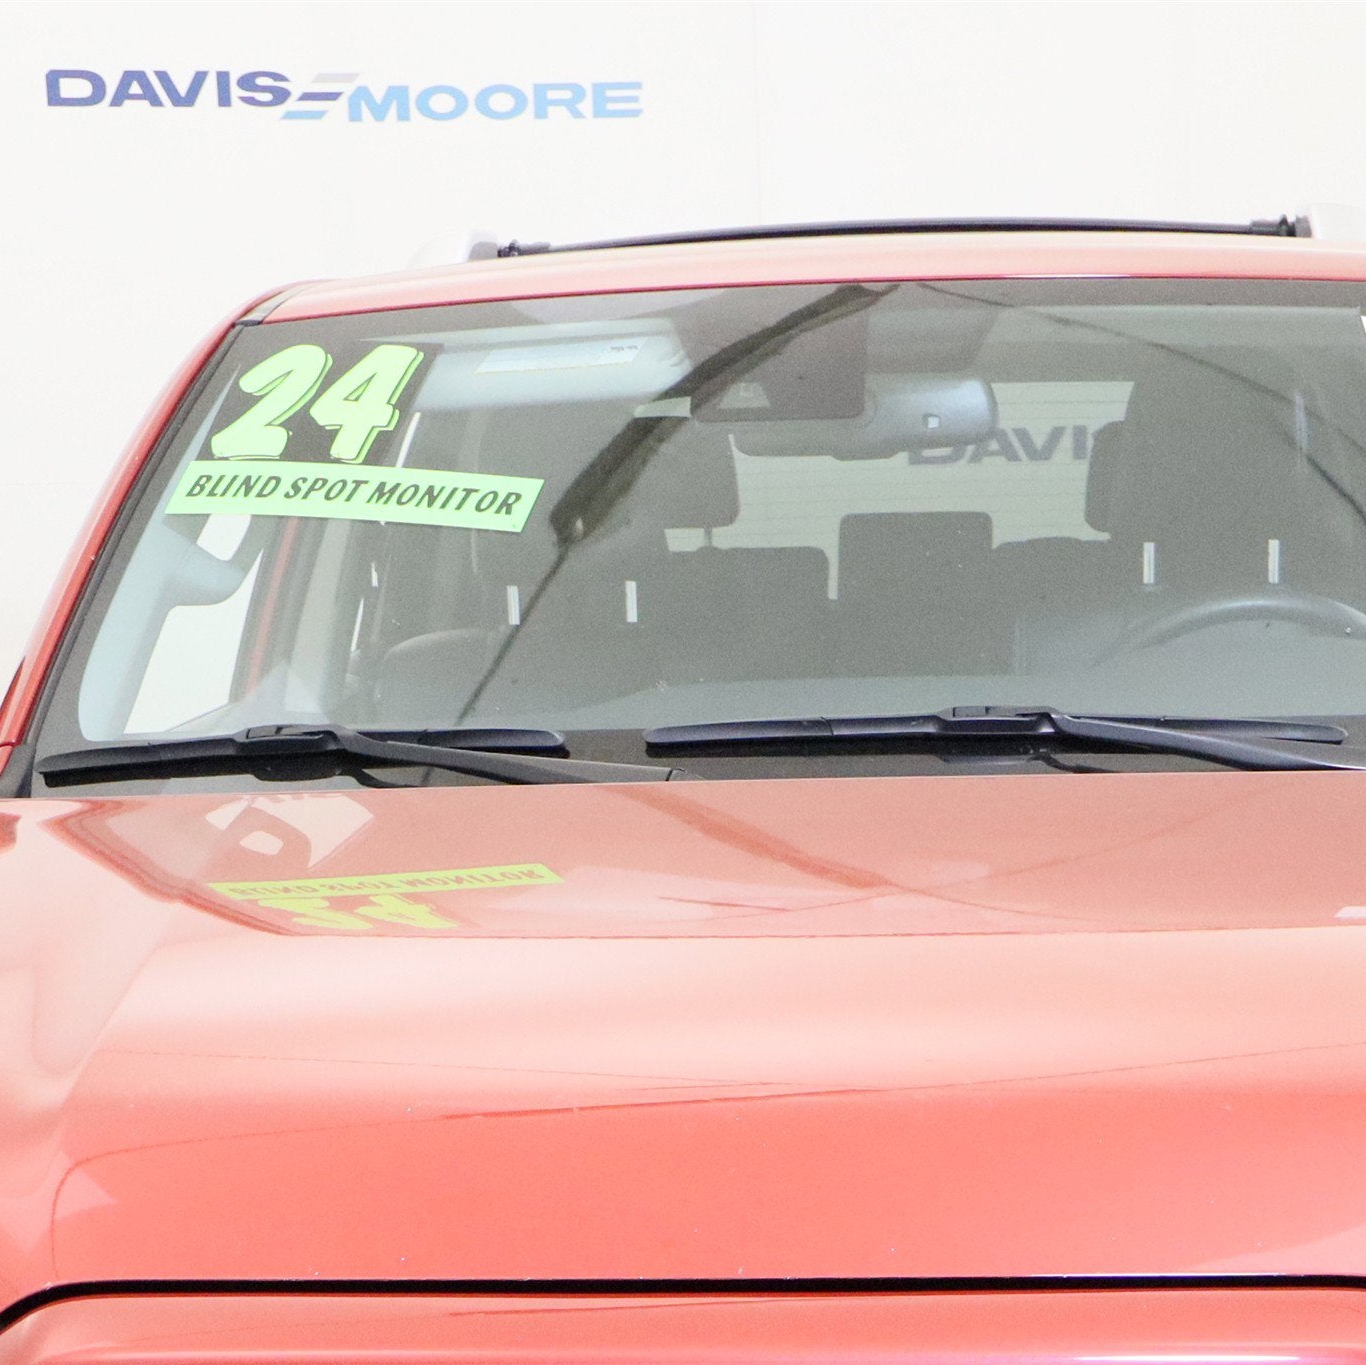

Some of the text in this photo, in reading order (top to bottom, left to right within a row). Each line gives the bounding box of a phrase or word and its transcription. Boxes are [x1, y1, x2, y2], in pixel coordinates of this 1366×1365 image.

[44, 69, 644, 122] DAVIS MOORE
[211, 344, 424, 463] 24
[185, 474, 523, 516] BLIND SPOT MONITOR
